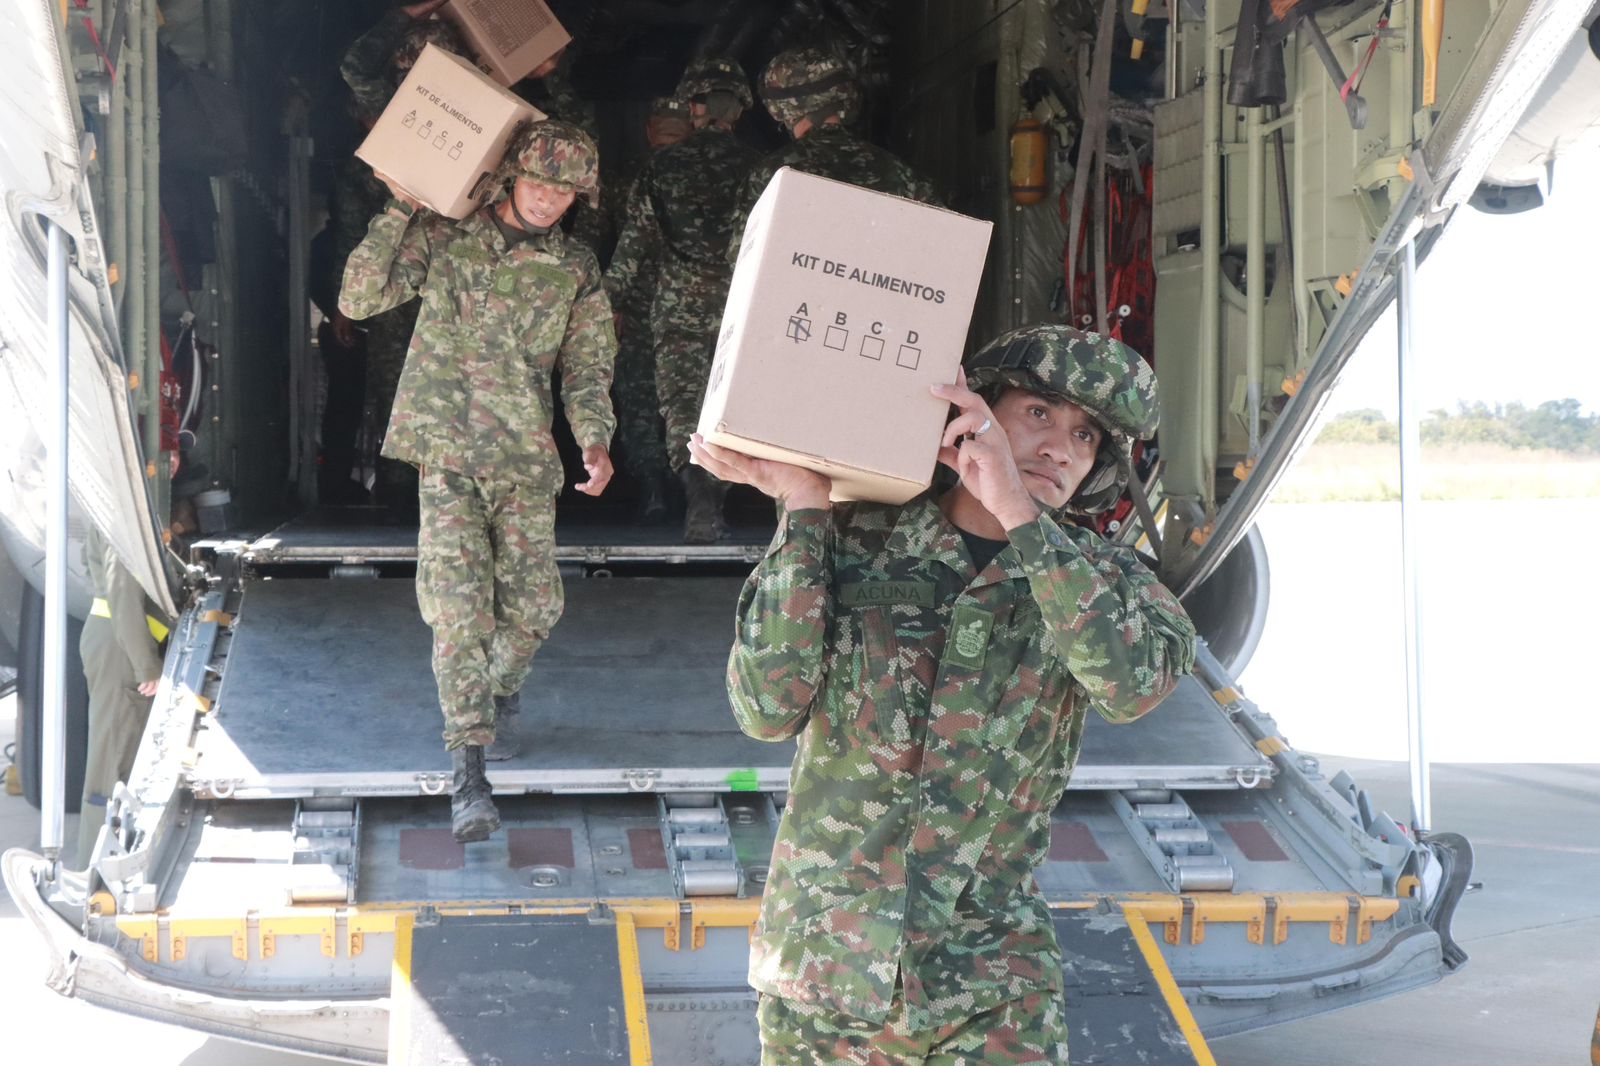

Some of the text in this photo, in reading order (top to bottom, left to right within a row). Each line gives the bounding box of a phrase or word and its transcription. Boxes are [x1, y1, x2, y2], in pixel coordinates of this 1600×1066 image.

[410, 109, 464, 149] A B C D
[415, 85, 483, 135] KIT DE ALIMENTOS
[791, 252, 946, 304] KIT DE ALIMENTOS
[796, 302, 919, 345] A B C D
